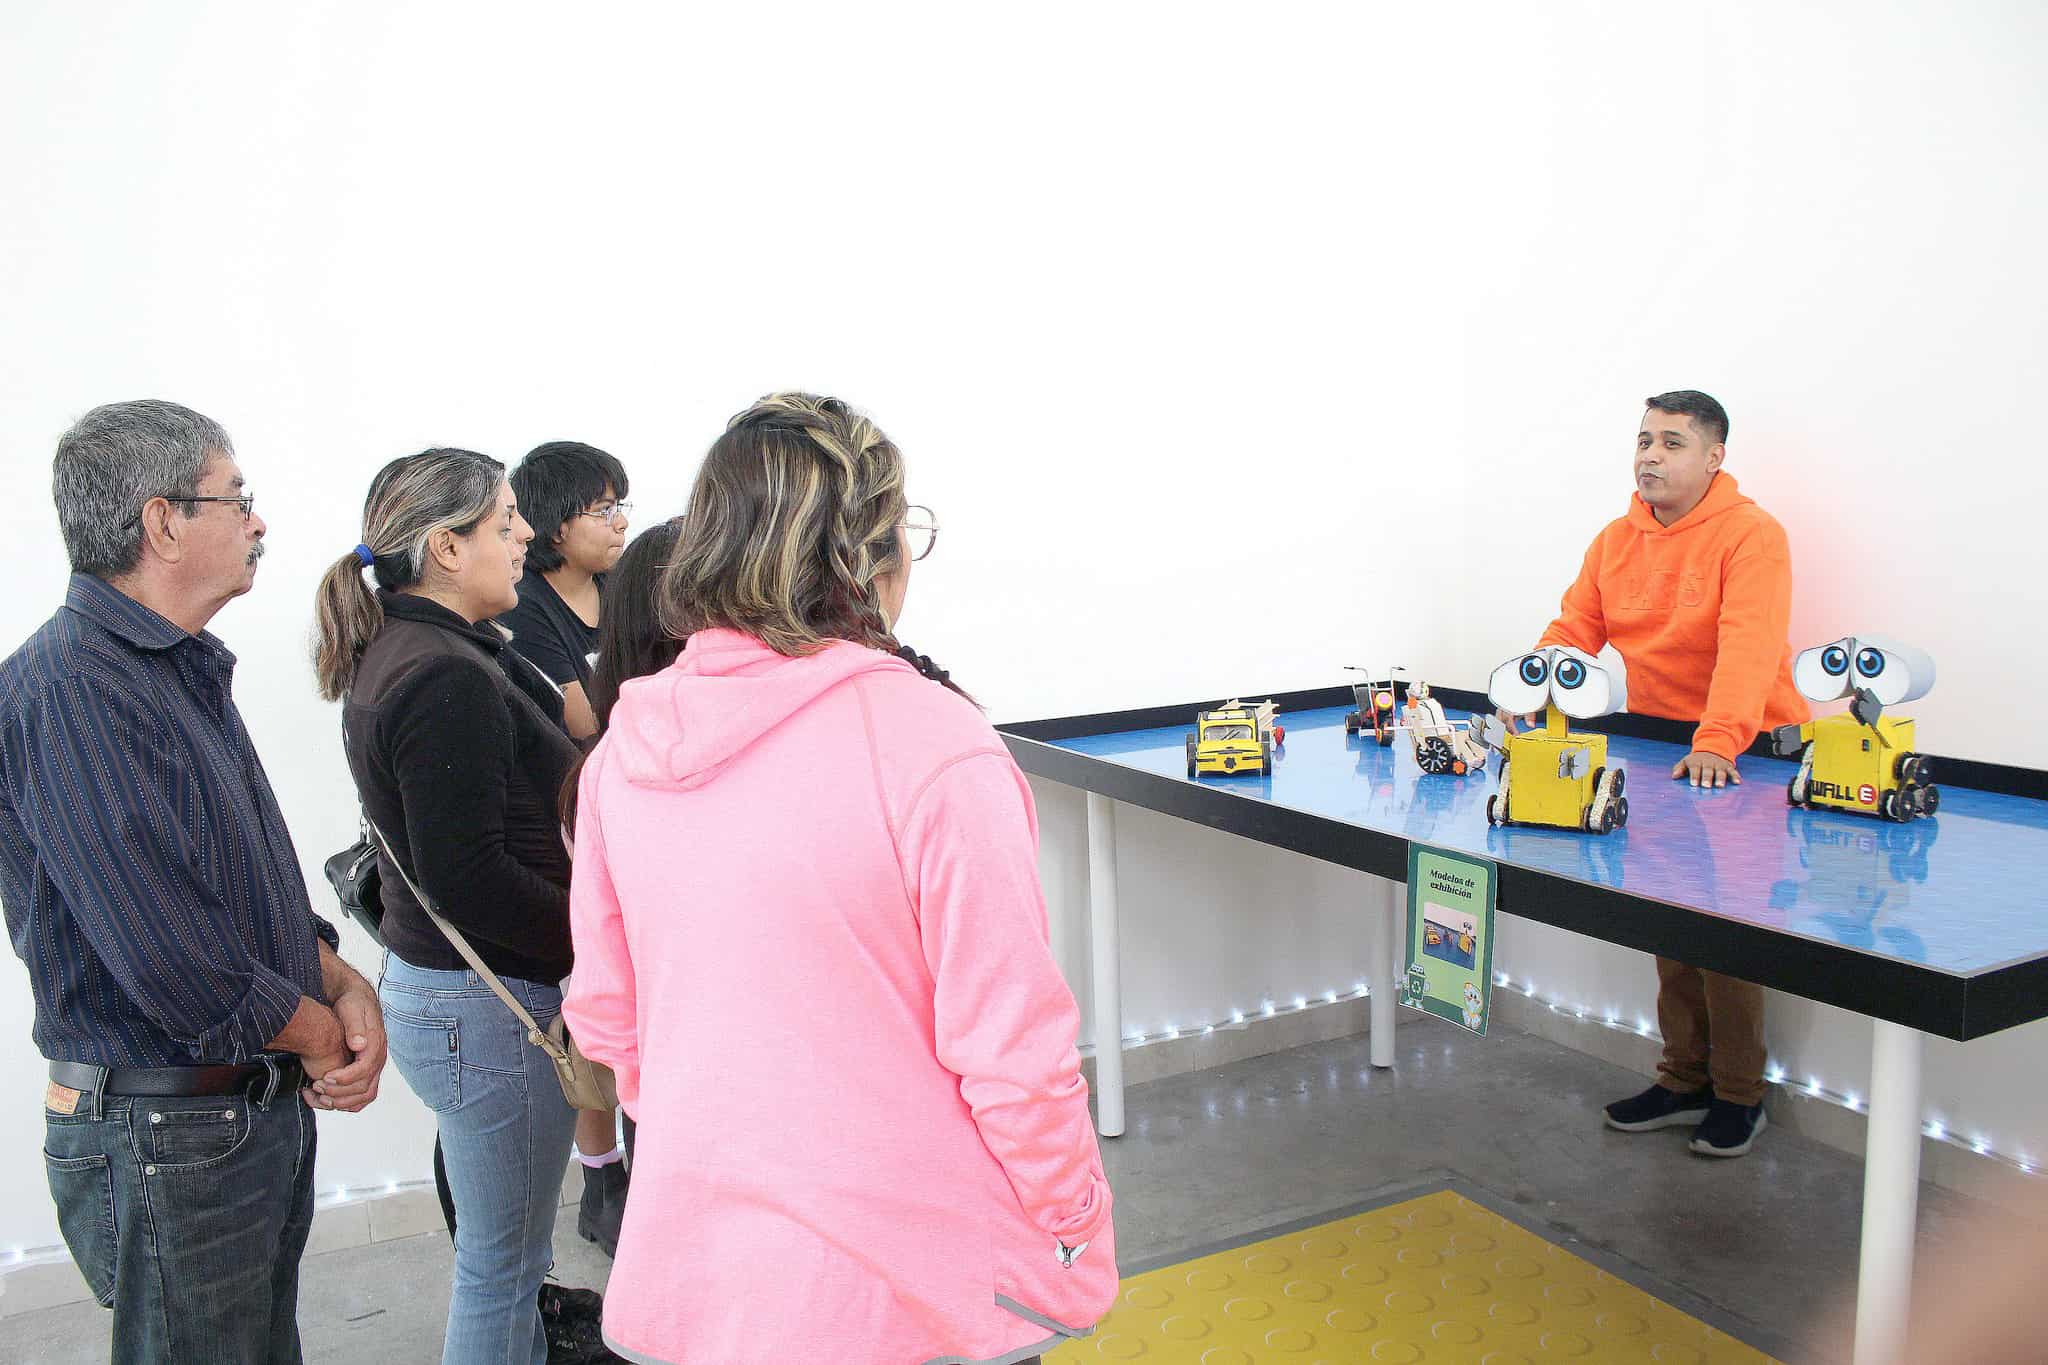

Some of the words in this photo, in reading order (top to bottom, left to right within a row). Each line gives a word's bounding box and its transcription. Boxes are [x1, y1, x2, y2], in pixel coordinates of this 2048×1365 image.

[1812, 780, 1855, 801] WALL
[1860, 787, 1873, 801] E
[1430, 869, 1463, 885] Modelos
[1464, 878, 1476, 888] de
[1430, 881, 1472, 899] exhibición
